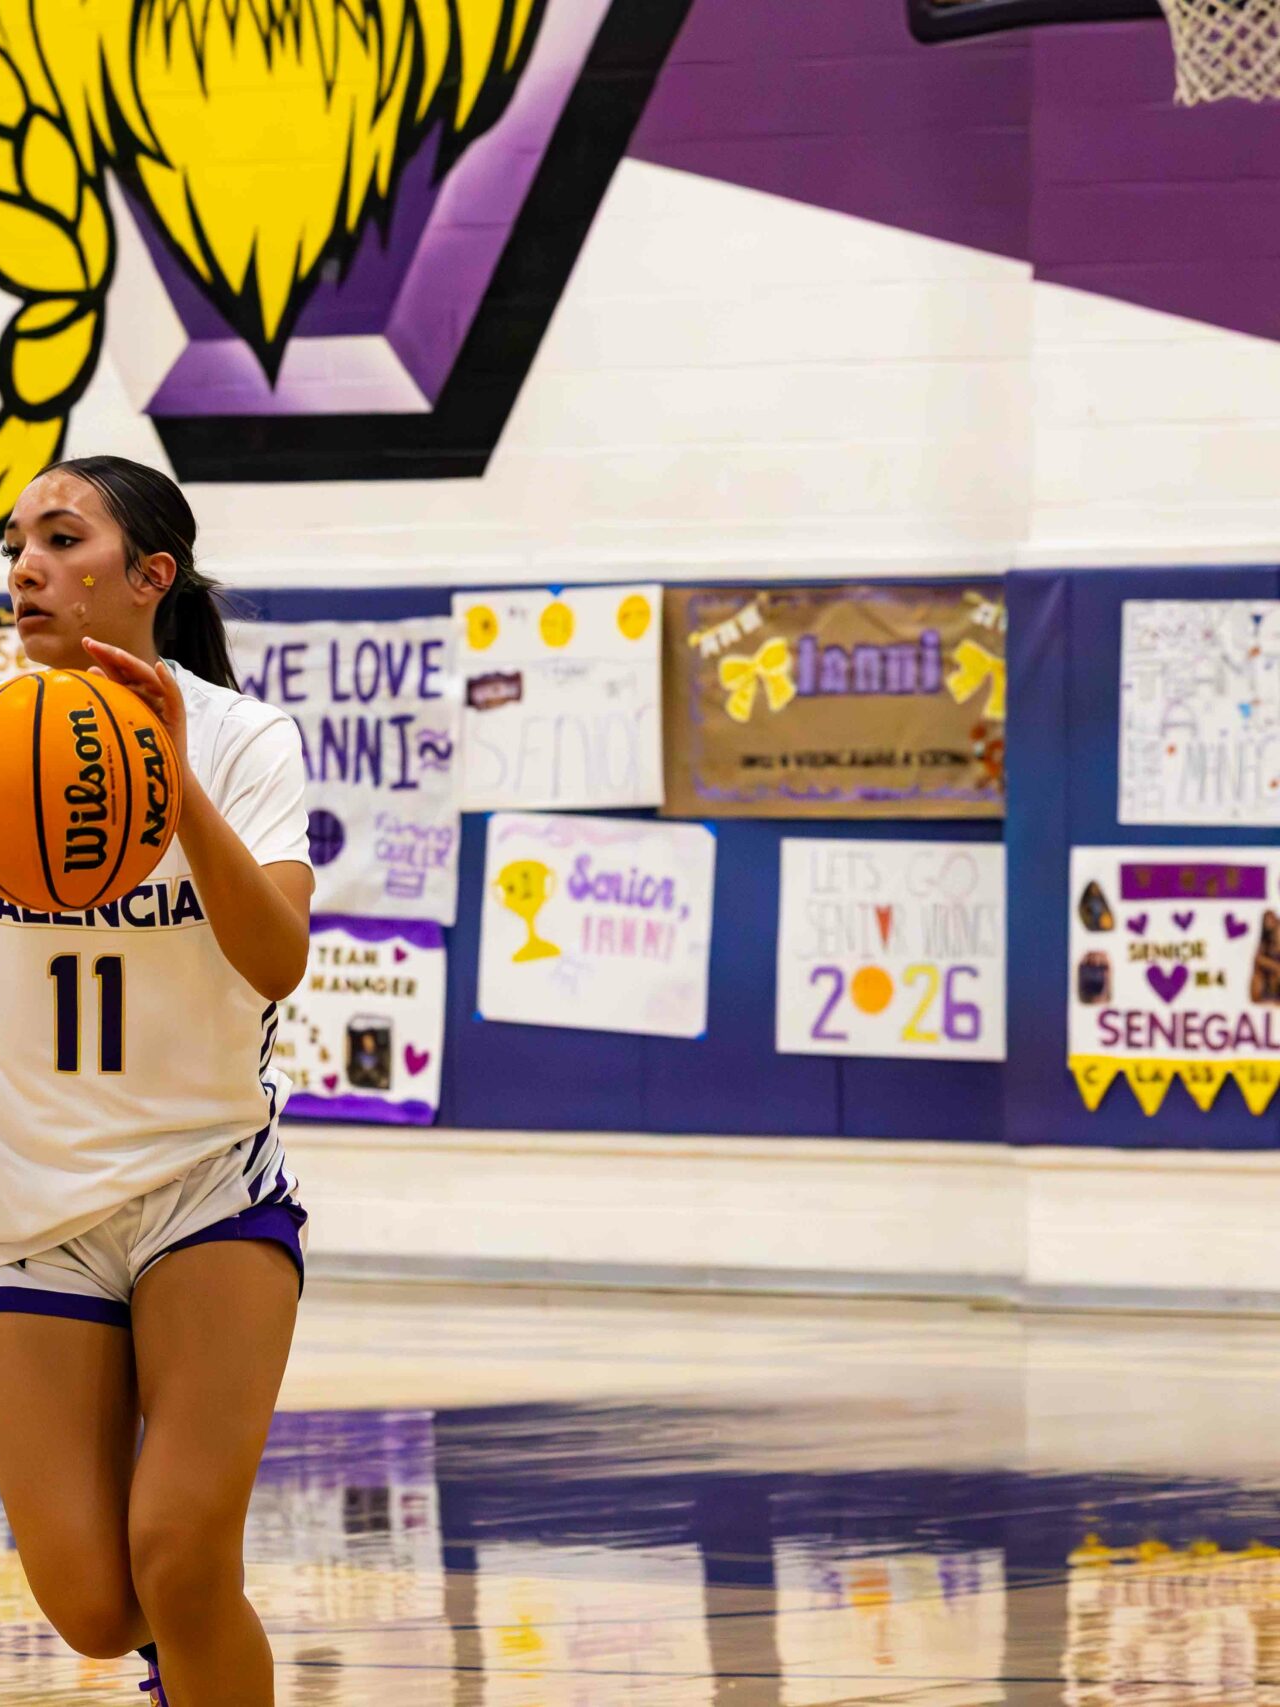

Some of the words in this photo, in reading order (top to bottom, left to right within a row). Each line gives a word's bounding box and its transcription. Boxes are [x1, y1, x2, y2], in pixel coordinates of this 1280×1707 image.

[239, 643, 308, 704] WE
[329, 640, 443, 704] LOVE
[797, 629, 942, 696] Ianni
[63, 705, 109, 874] Wilson
[134, 726, 171, 848] NCAA
[308, 976, 419, 998] MANAGER
[316, 946, 380, 966] TEAM
[47, 952, 126, 1075] 11
